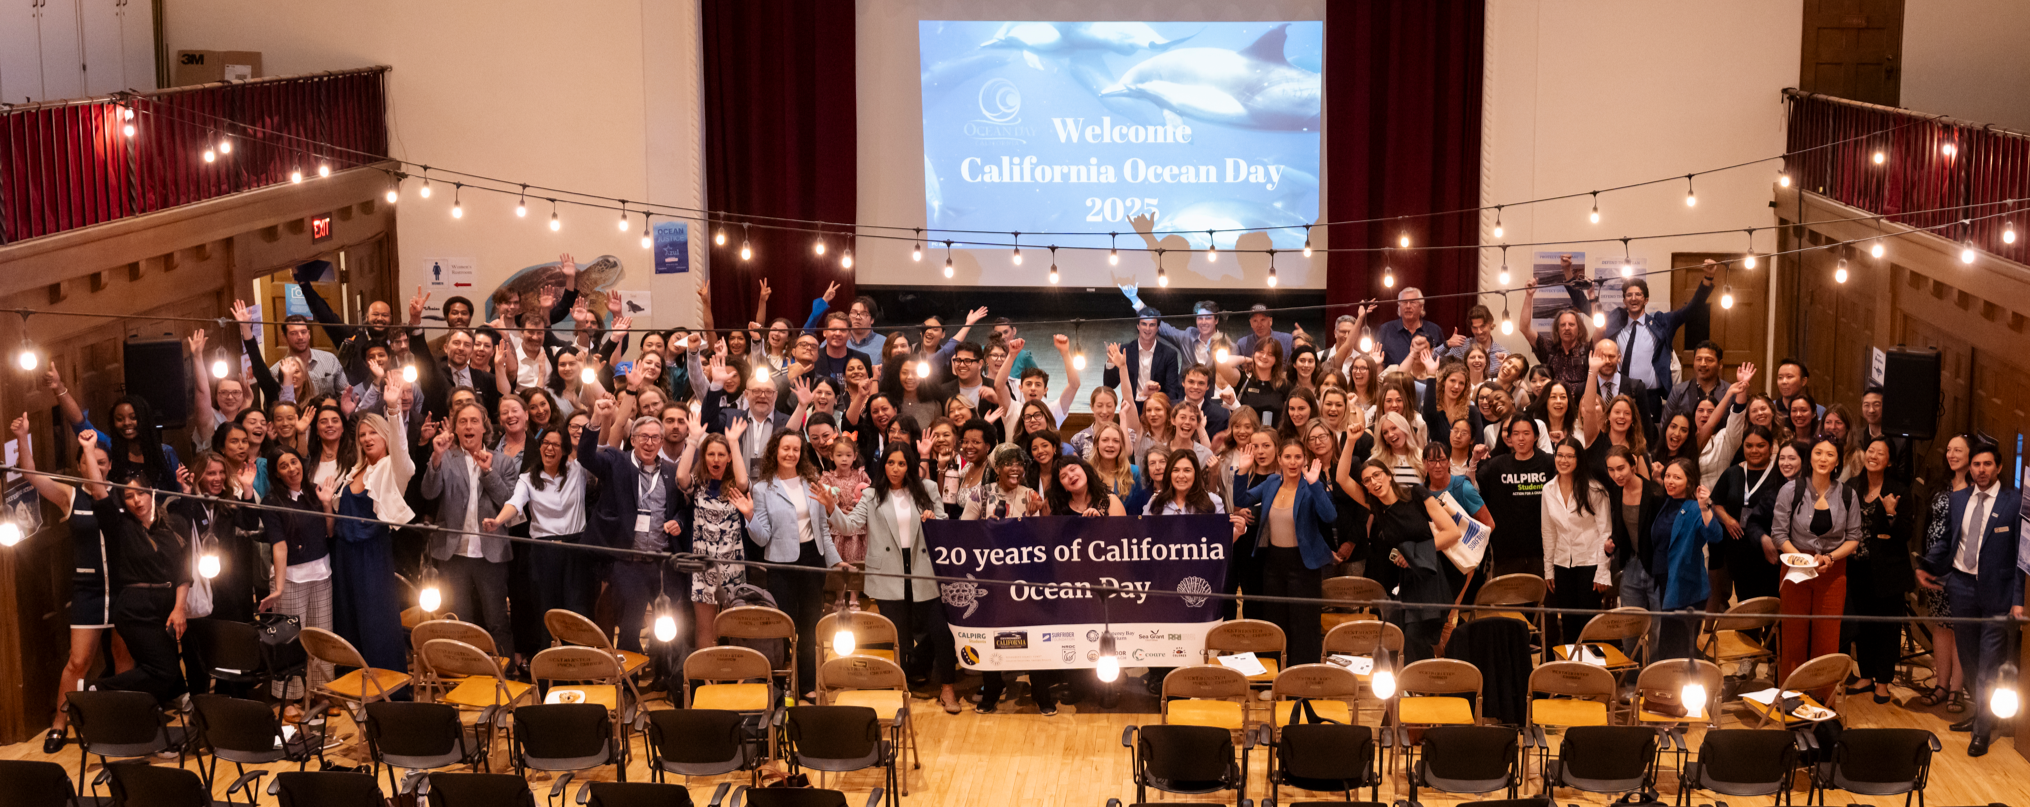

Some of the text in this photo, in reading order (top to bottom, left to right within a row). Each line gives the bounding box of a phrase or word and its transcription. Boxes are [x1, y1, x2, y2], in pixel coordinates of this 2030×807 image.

[181, 53, 204, 65] 3M
[964, 122, 1012, 136] OCEAN
[1052, 116, 1192, 144] Welcome
[961, 155, 1285, 191] California Ocean Day
[1085, 197, 1160, 223] 2025
[312, 217, 330, 239] EXIT
[657, 227, 684, 235] OCEAN
[1501, 472, 1546, 484] CALPIRG
[1517, 483, 1543, 491] Student
[935, 537, 1225, 571] 20 years of California
[1010, 577, 1151, 604] Ocean Day
[958, 631, 986, 640] CALPIRG
